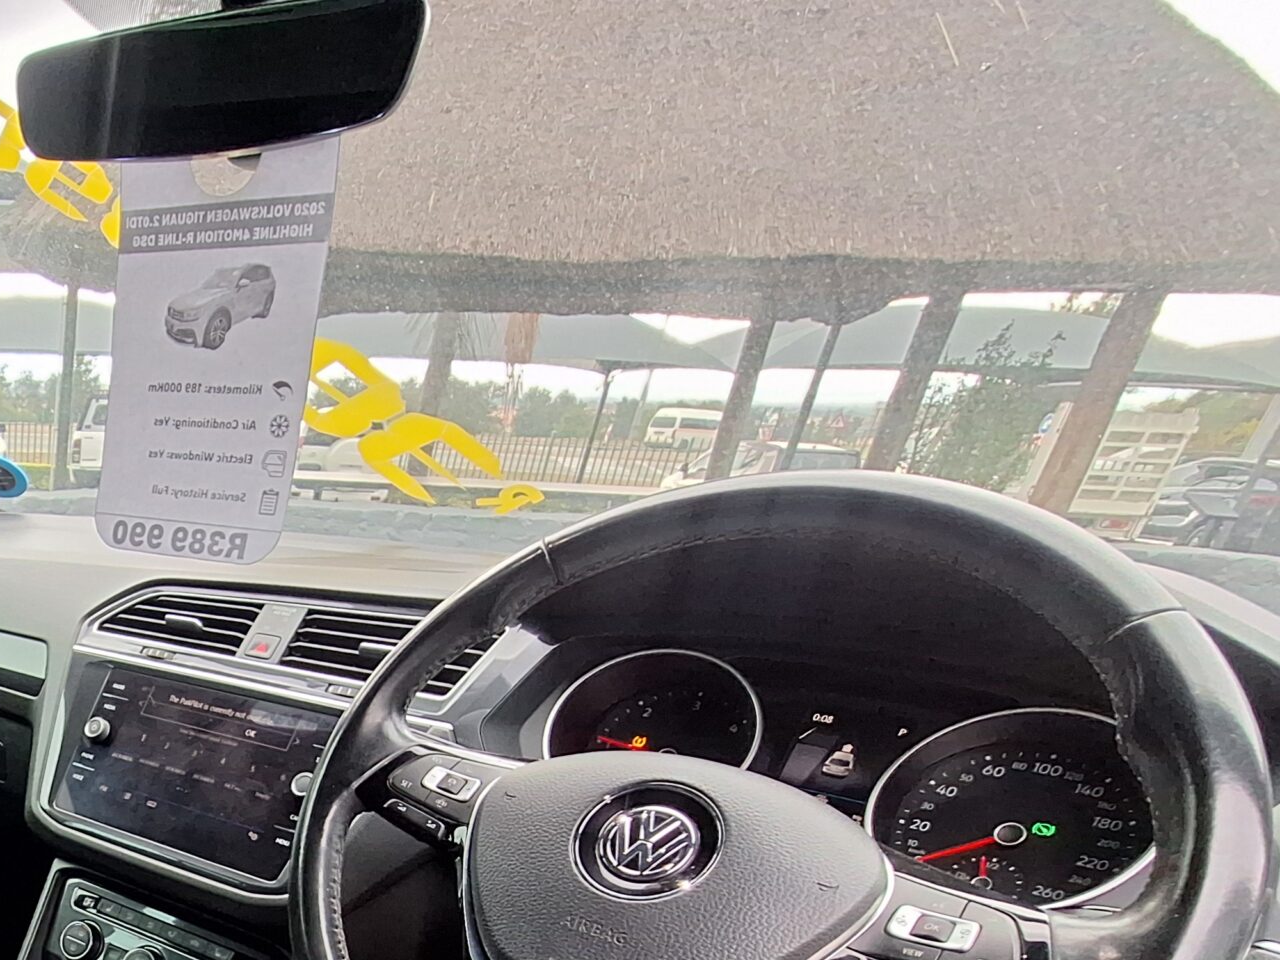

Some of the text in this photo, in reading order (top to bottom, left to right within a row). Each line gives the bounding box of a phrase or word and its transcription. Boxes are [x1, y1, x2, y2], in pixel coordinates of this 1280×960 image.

[642, 707, 653, 718] 2
[897, 728, 908, 736] P
[982, 764, 1006, 778] 60
[1031, 761, 1063, 777] 100
[400, 779, 413, 789] SET
[959, 773, 974, 783] 50
[935, 784, 958, 798] 40
[1074, 783, 1105, 798] 140
[920, 801, 934, 811] 30
[909, 818, 931, 832] 20
[1091, 816, 1123, 832] 180
[907, 838, 919, 848] 10
[1075, 855, 1110, 872] 220
[1031, 884, 1066, 901] 260
[923, 922, 940, 933] OK
[902, 947, 924, 958] VIEW
